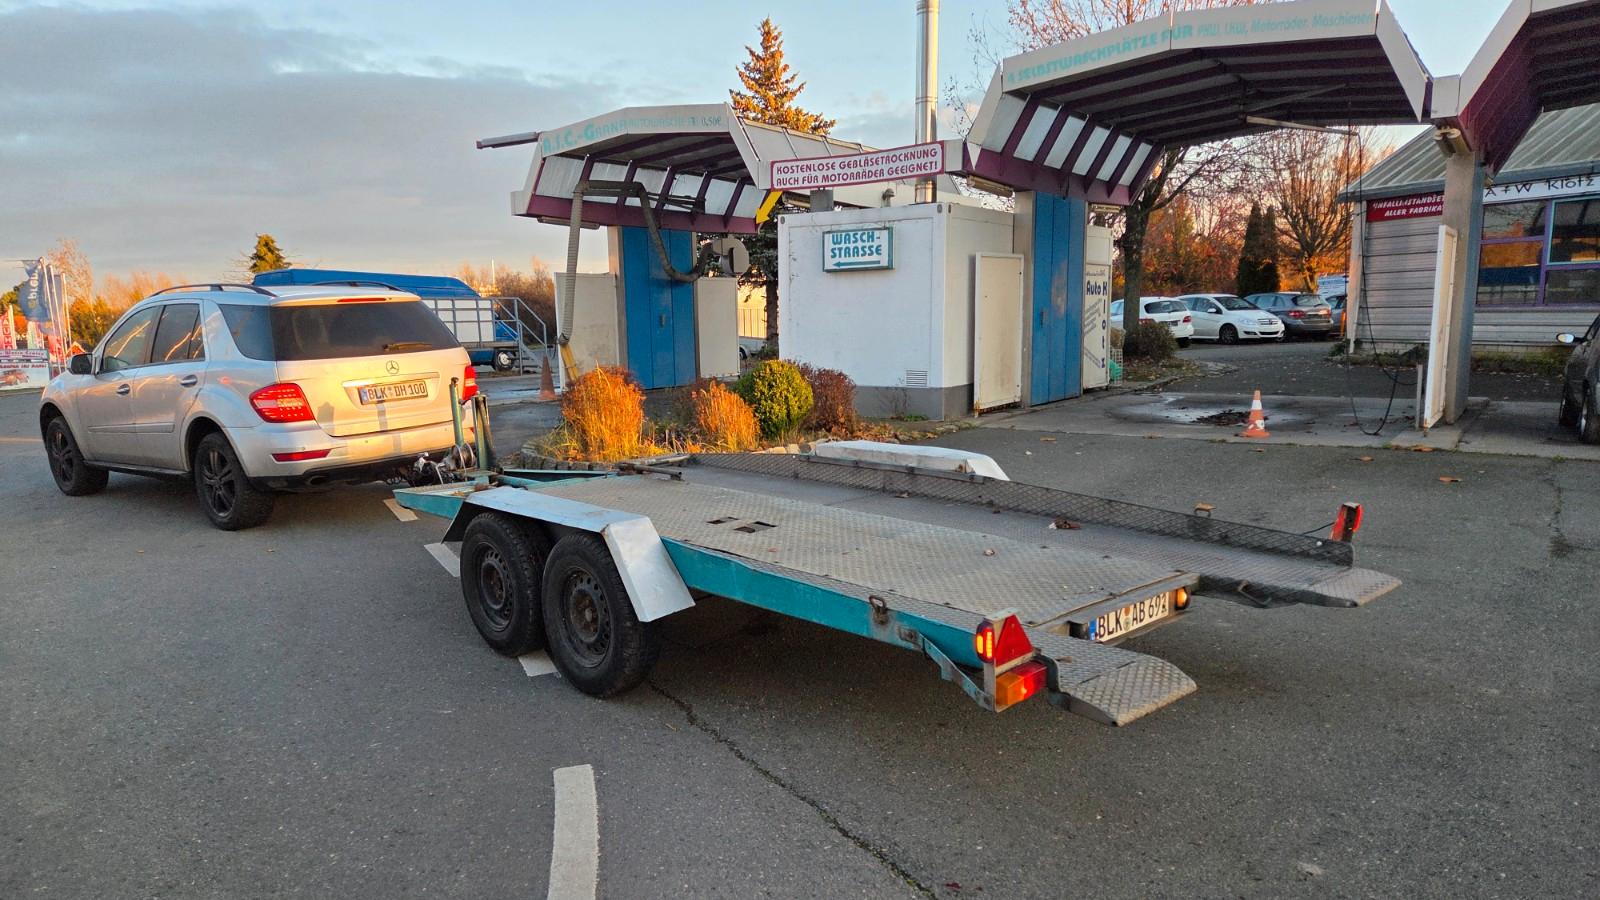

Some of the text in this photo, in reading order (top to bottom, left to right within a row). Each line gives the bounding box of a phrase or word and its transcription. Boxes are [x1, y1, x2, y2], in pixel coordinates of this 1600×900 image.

[776, 148, 938, 175] KOSTENLOSE GEBLÄSETROCKNUNG
[776, 161, 938, 186] AUCH FÜR MOTORRÄDER GEEIGNET!
[1384, 208, 1406, 217] ALLER
[831, 230, 881, 246] WASCH-
[830, 245, 882, 259] STRASSE
[1086, 280, 1101, 295] Auto
[367, 383, 425, 400] BLK DH 100
[1098, 609, 1122, 638] BLK
[1131, 601, 1145, 626] AB
